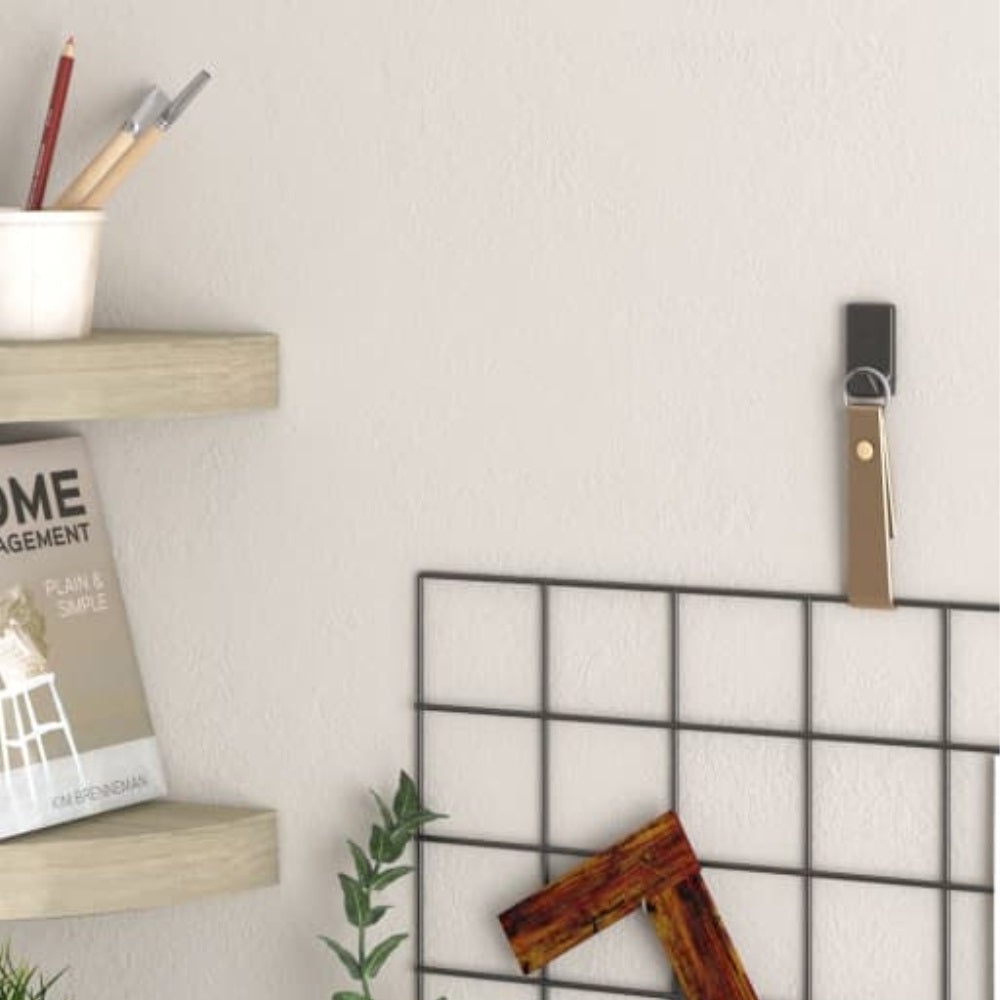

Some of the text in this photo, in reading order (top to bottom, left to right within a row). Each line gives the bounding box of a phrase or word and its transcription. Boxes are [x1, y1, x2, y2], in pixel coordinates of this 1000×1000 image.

[45, 571, 105, 597] PLAIN &
[58, 593, 107, 618] SIMPLE
